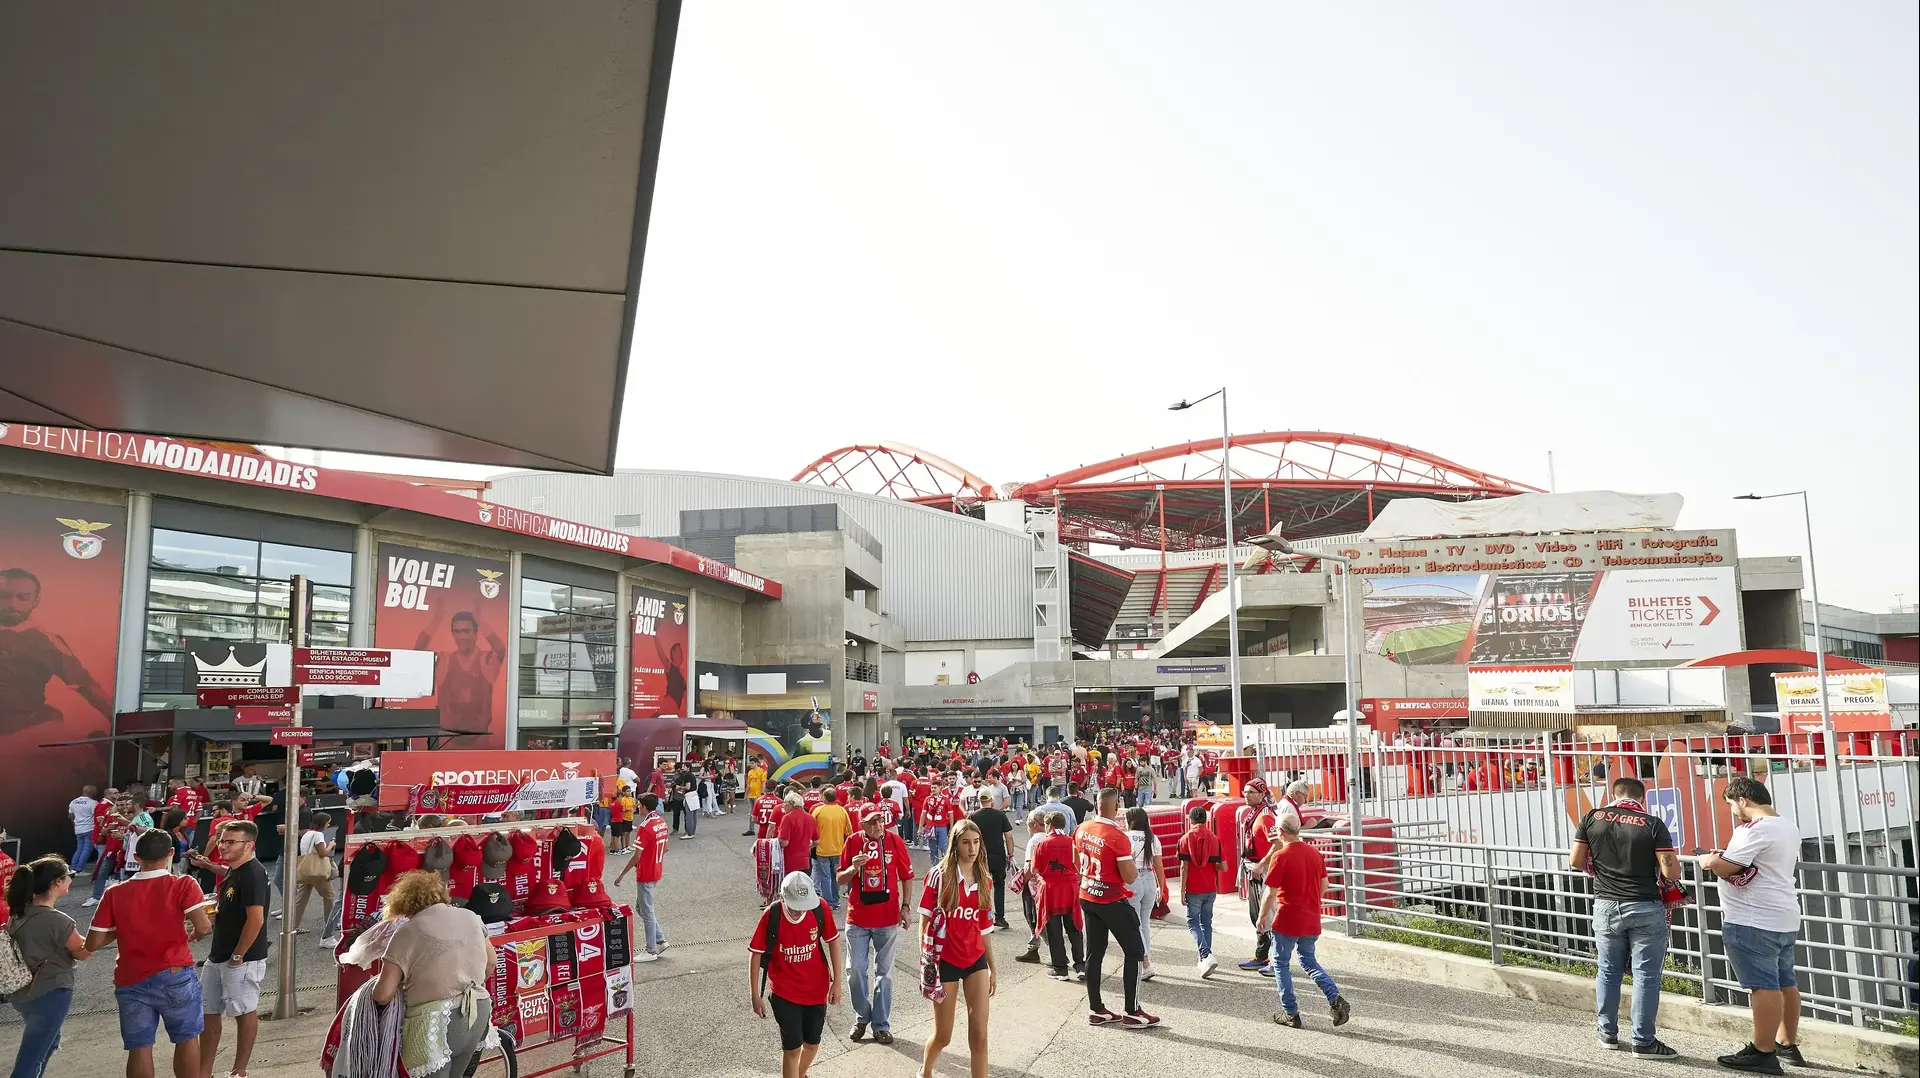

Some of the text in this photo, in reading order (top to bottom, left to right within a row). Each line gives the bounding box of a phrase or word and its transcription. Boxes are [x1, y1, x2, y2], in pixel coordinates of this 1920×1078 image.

[1379, 547, 1427, 558] Plasma
[1446, 545, 1466, 556] TV
[1485, 543, 1515, 555] DVD
[1641, 536, 1718, 550] Fotografia
[1425, 558, 1546, 573] Electrodomésticos
[1563, 556, 1583, 568] CD
[1602, 552, 1724, 567] Telecomunicação
[388, 556, 455, 589] VOLEI
[384, 582, 430, 611] BOL
[1628, 596, 1692, 607] BILHETES
[635, 596, 666, 619] ANDE
[1628, 608, 1693, 621] TICKETS
[635, 615, 656, 636] BOL
[1431, 701, 1467, 709] OFFICIAL
[1481, 698, 1560, 707] BIFANAS ENTREMEADA
[1790, 697, 1820, 705] BIFANAS
[1844, 696, 1875, 704] PREGOS
[585, 780, 594, 800] PARIS
[457, 795, 482, 805] SPORT
[483, 792, 509, 804] LISBOA
[1859, 789, 1896, 808] Rentng
[1605, 811, 1646, 827] SAGRES
[1082, 831, 1105, 848] SAGRES
[1087, 887, 1104, 897] FARO
[780, 942, 817, 955] Emirates
[557, 964, 570, 981] REI
[498, 981, 508, 1006] SPORT
[520, 997, 548, 1010] ODUTO
